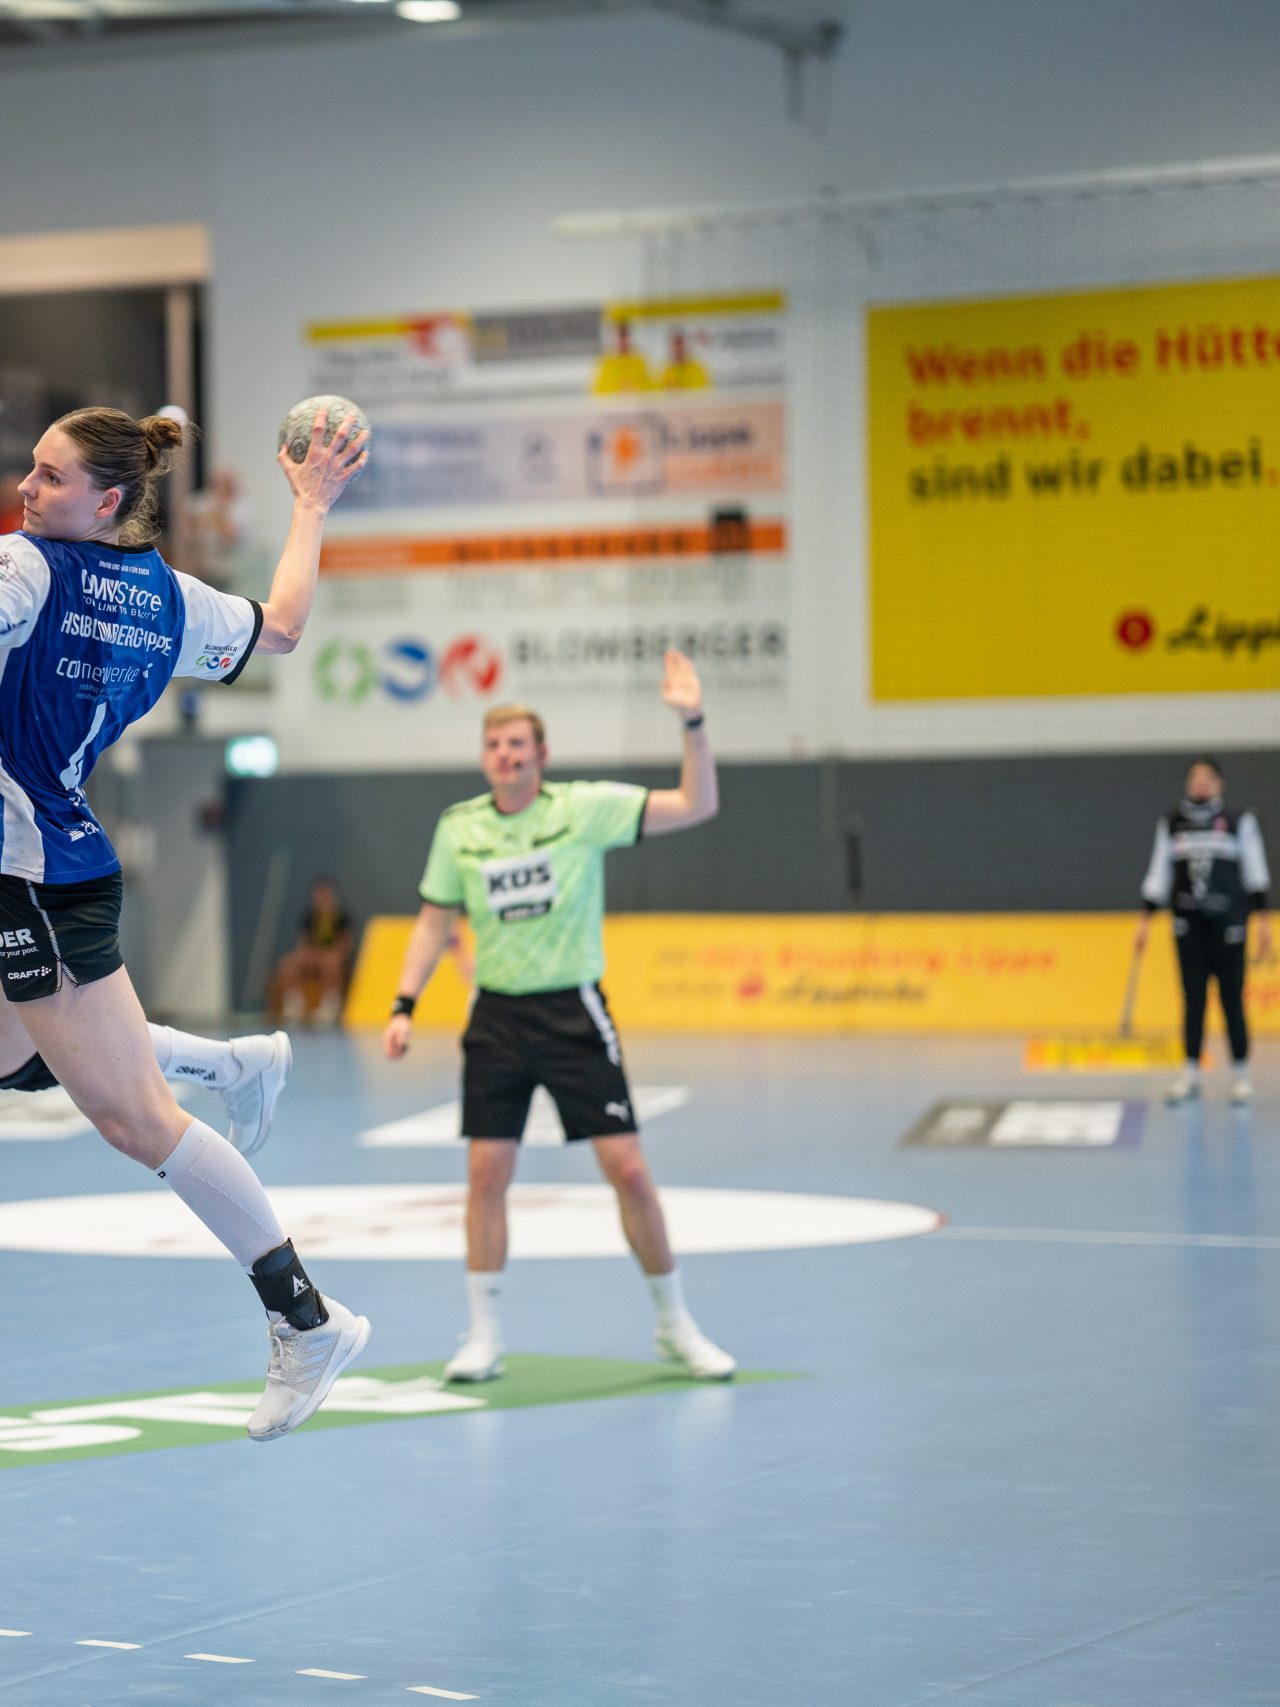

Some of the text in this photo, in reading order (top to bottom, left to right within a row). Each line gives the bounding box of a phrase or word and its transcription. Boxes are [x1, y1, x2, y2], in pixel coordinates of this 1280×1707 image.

[904, 343, 1046, 387] Wenn
[1062, 329, 1139, 380] die
[910, 453, 1012, 502] sind
[1024, 448, 1105, 494] wir
[7, 968, 41, 980] CRAFT
